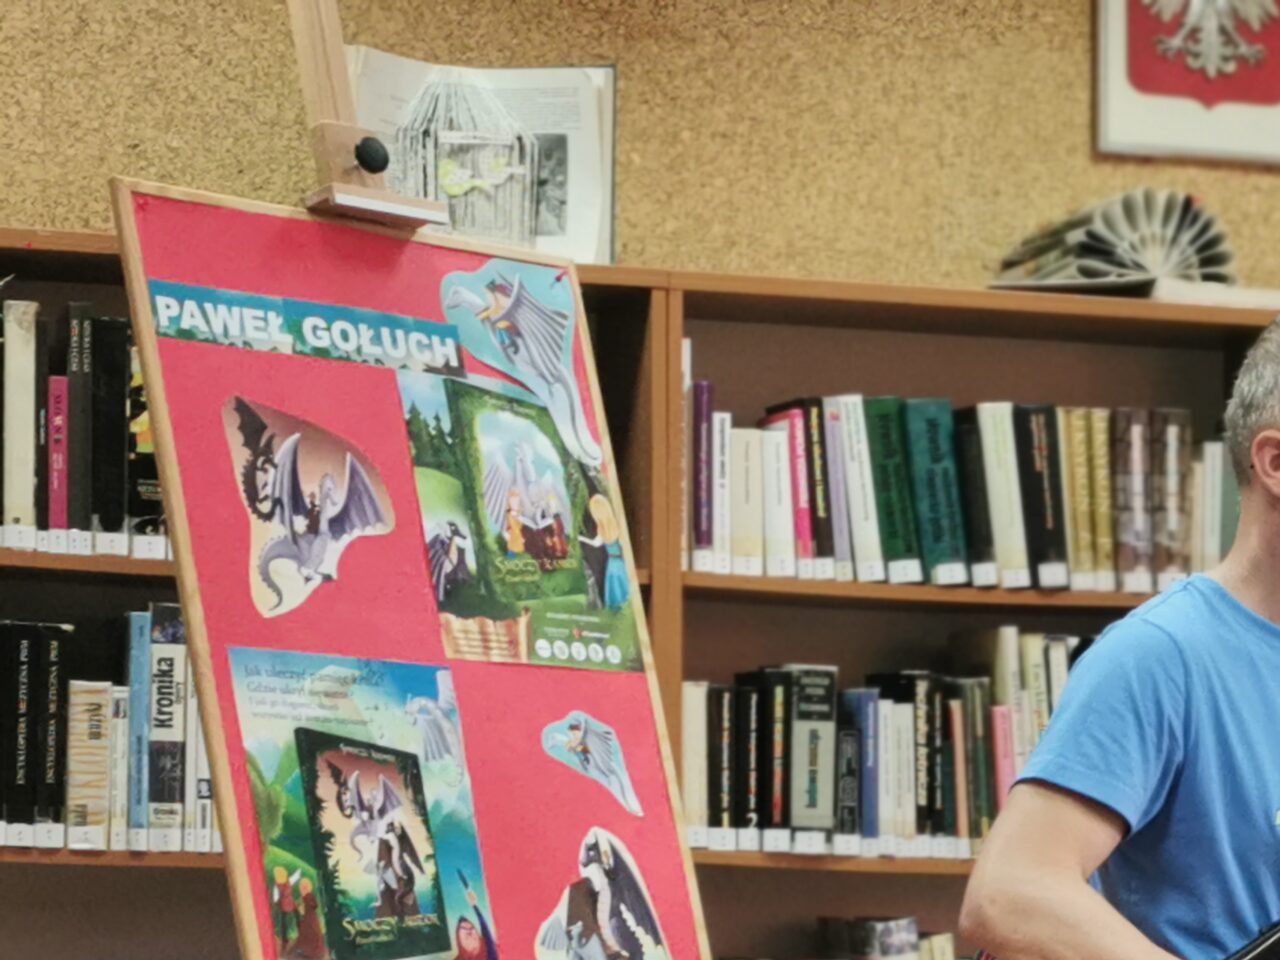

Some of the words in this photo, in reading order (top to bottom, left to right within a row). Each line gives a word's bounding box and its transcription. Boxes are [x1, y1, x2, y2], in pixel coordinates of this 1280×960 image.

[155, 293, 294, 345] PAWEŁ
[301, 313, 460, 369] GOŁUCH
[152, 656, 176, 730] Kronika
